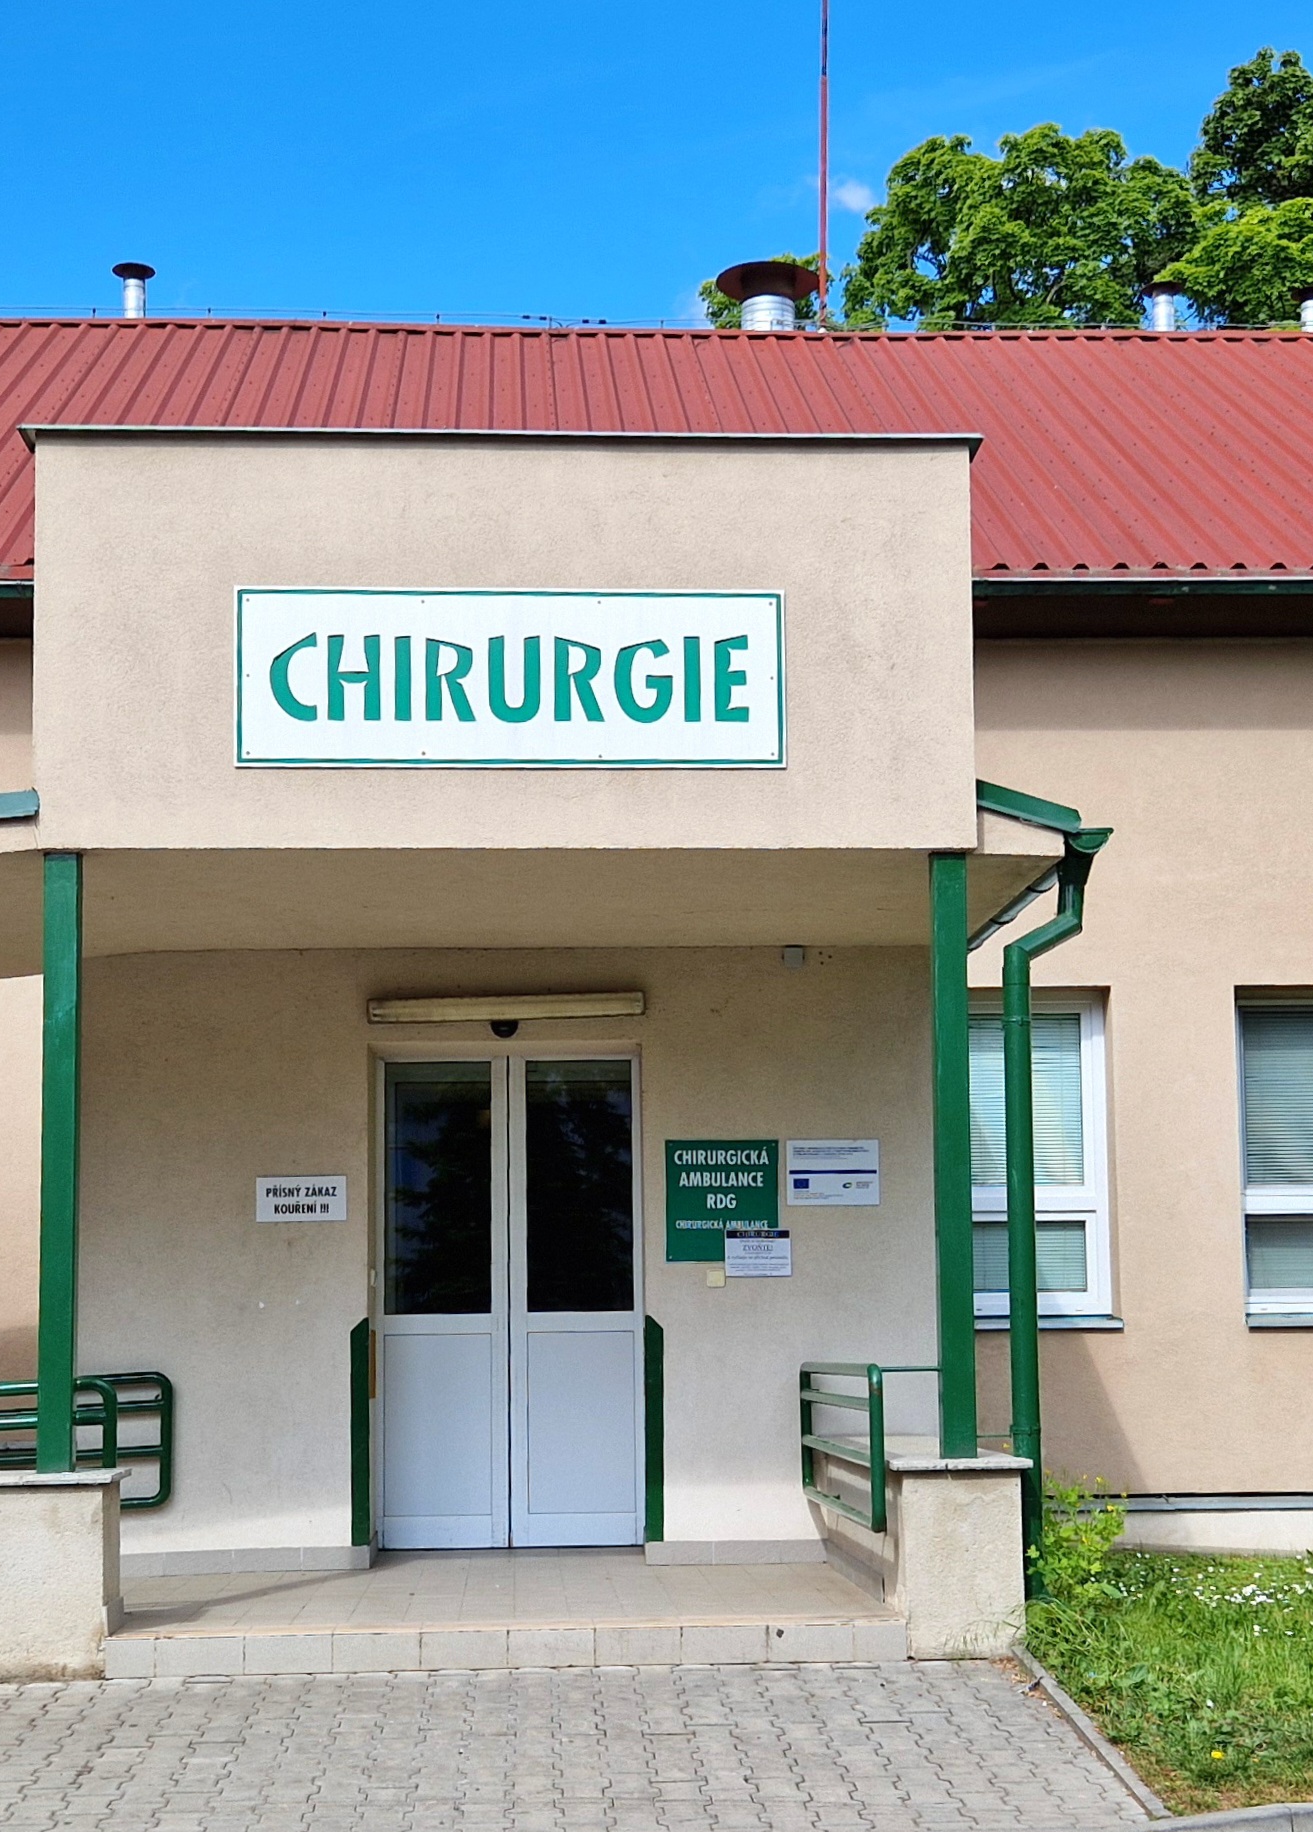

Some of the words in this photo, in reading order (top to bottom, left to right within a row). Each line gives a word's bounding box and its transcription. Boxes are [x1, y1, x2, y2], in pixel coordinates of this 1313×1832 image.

[269, 631, 751, 724] CHIRURGIE
[674, 1146, 769, 1165] CHIRURGICKÁ
[679, 1171, 764, 1187] AMBULANCE
[265, 1184, 301, 1198] PŘÍSNÝ
[304, 1183, 338, 1197] ZÁKAZ
[274, 1201, 317, 1214] KOUŘENÍ
[319, 1203, 330, 1214] !!!
[706, 1193, 737, 1209] RDG
[675, 1218, 723, 1229] CHIRURGICKÁ
